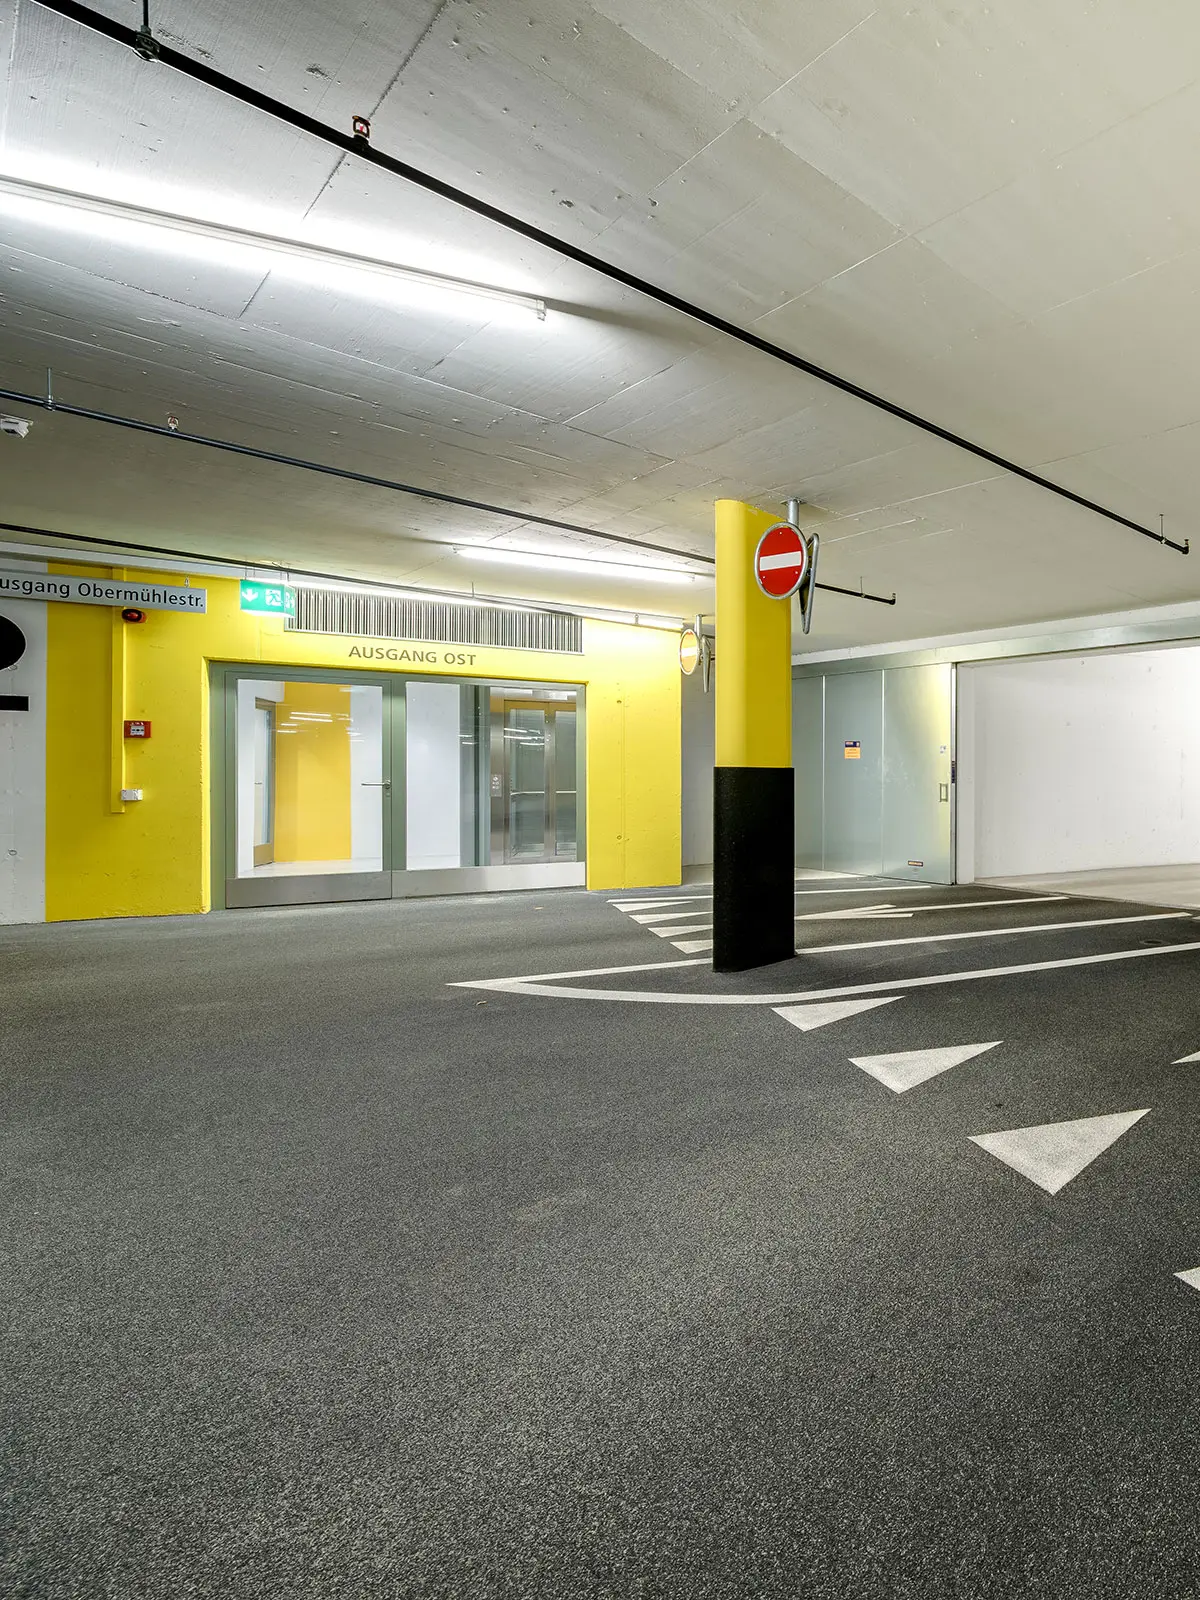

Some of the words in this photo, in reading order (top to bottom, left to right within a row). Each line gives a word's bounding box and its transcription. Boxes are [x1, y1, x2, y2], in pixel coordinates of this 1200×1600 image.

[0, 578, 70, 598] usgang
[77, 582, 204, 608] Obermühlestr.
[348, 645, 437, 663] AUSGANG
[443, 652, 476, 666] OST
